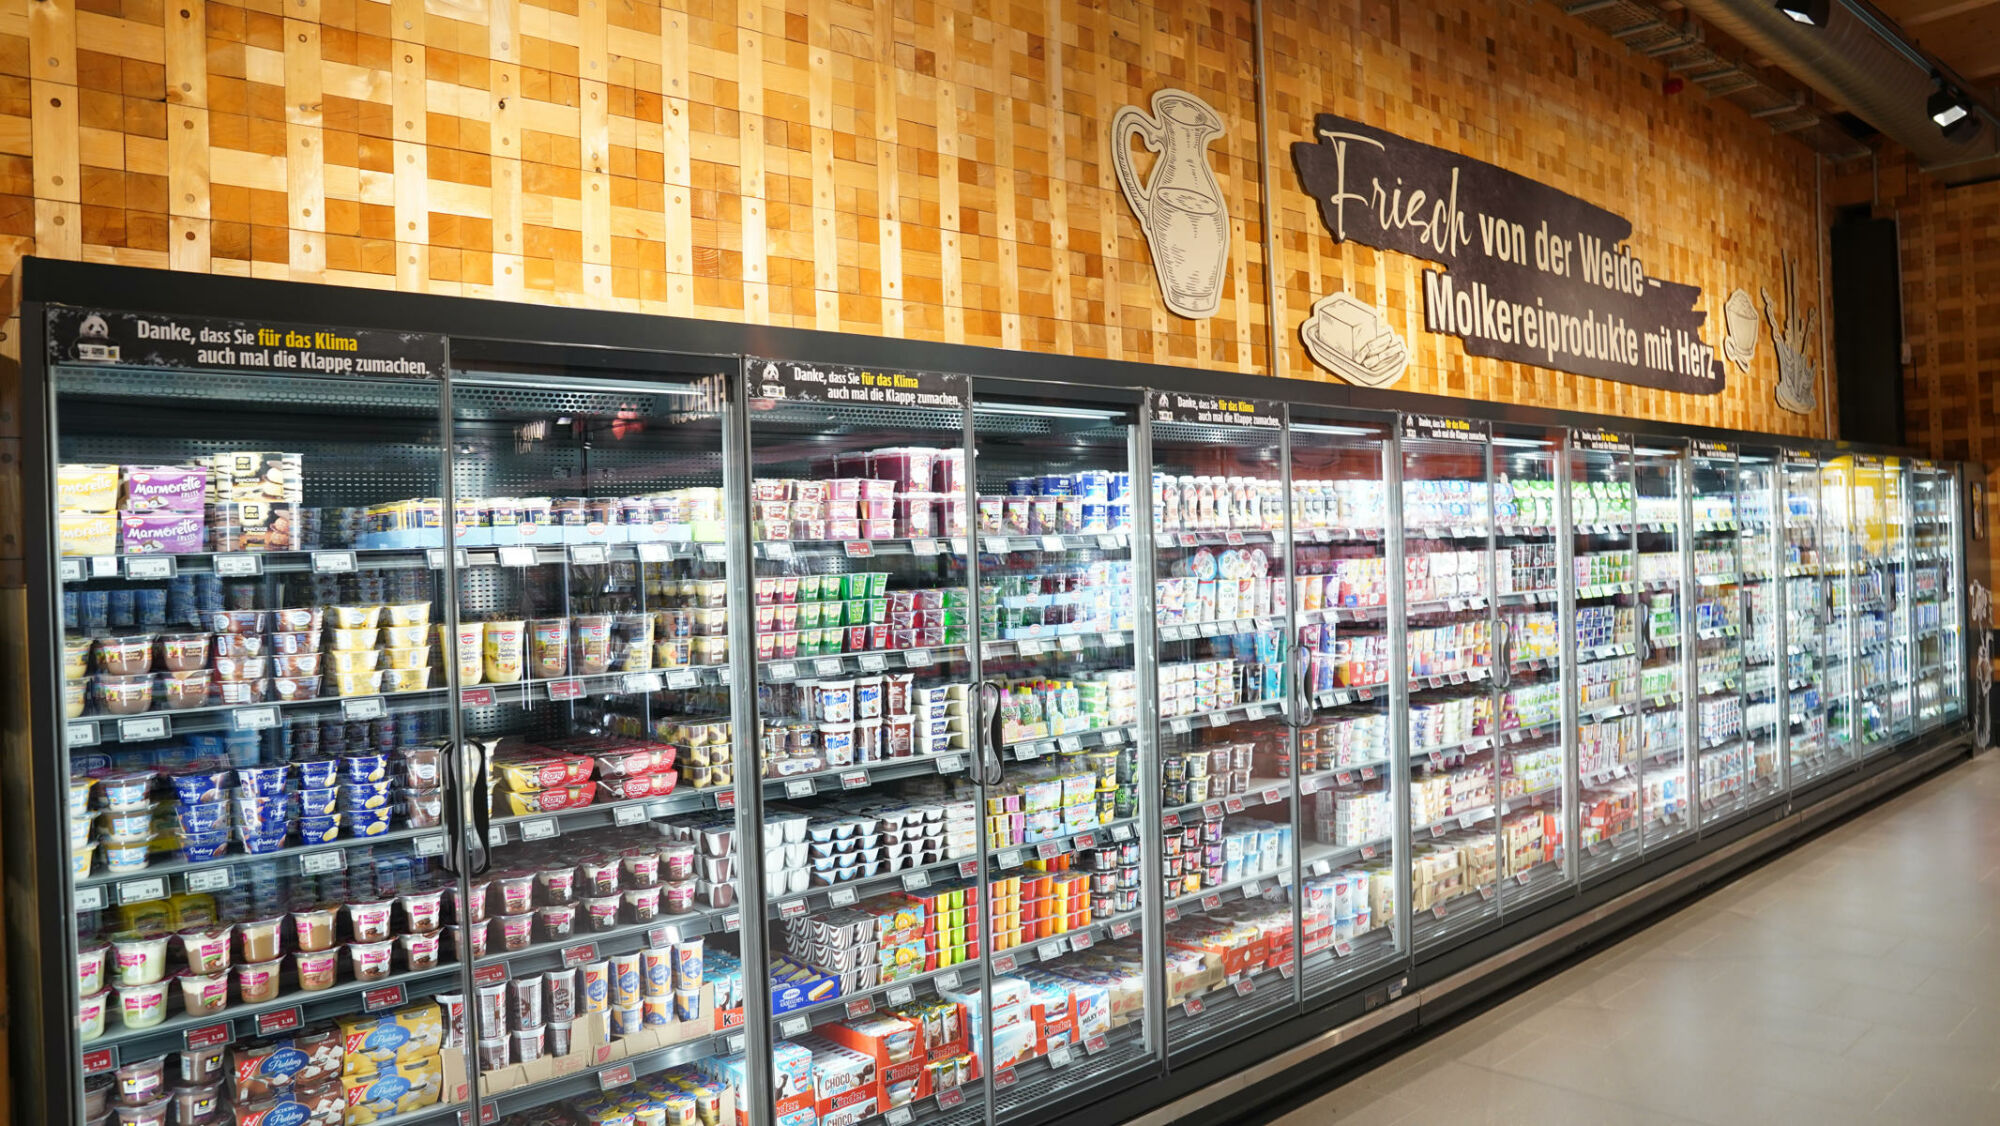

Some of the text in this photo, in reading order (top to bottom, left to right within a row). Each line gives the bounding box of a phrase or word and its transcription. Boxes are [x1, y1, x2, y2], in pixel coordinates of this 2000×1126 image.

[1319, 129, 1471, 257] Frisch
[1479, 212, 1527, 266] von
[1535, 220, 1573, 279] der
[1578, 231, 1644, 297] Weide
[1427, 270, 1716, 380] Molkereiprodukte mit Herz
[137, 319, 358, 352] Danke, dass Sie für das Klima
[197, 347, 430, 375] auch mal die Klappe zumachen.
[794, 366, 918, 388] Danke, dass Sie für das Klima
[827, 386, 960, 406] auch mal die Klappe zumachen.
[134, 475, 202, 495] Marmorette
[127, 519, 200, 539] Marmorette
[1082, 1013, 1097, 1026] MILKY
[268, 1059, 302, 1072] Pudding
[825, 1073, 850, 1090] CHOCO
[831, 1090, 867, 1110] Kinder
[270, 1112, 304, 1126] Pudding
